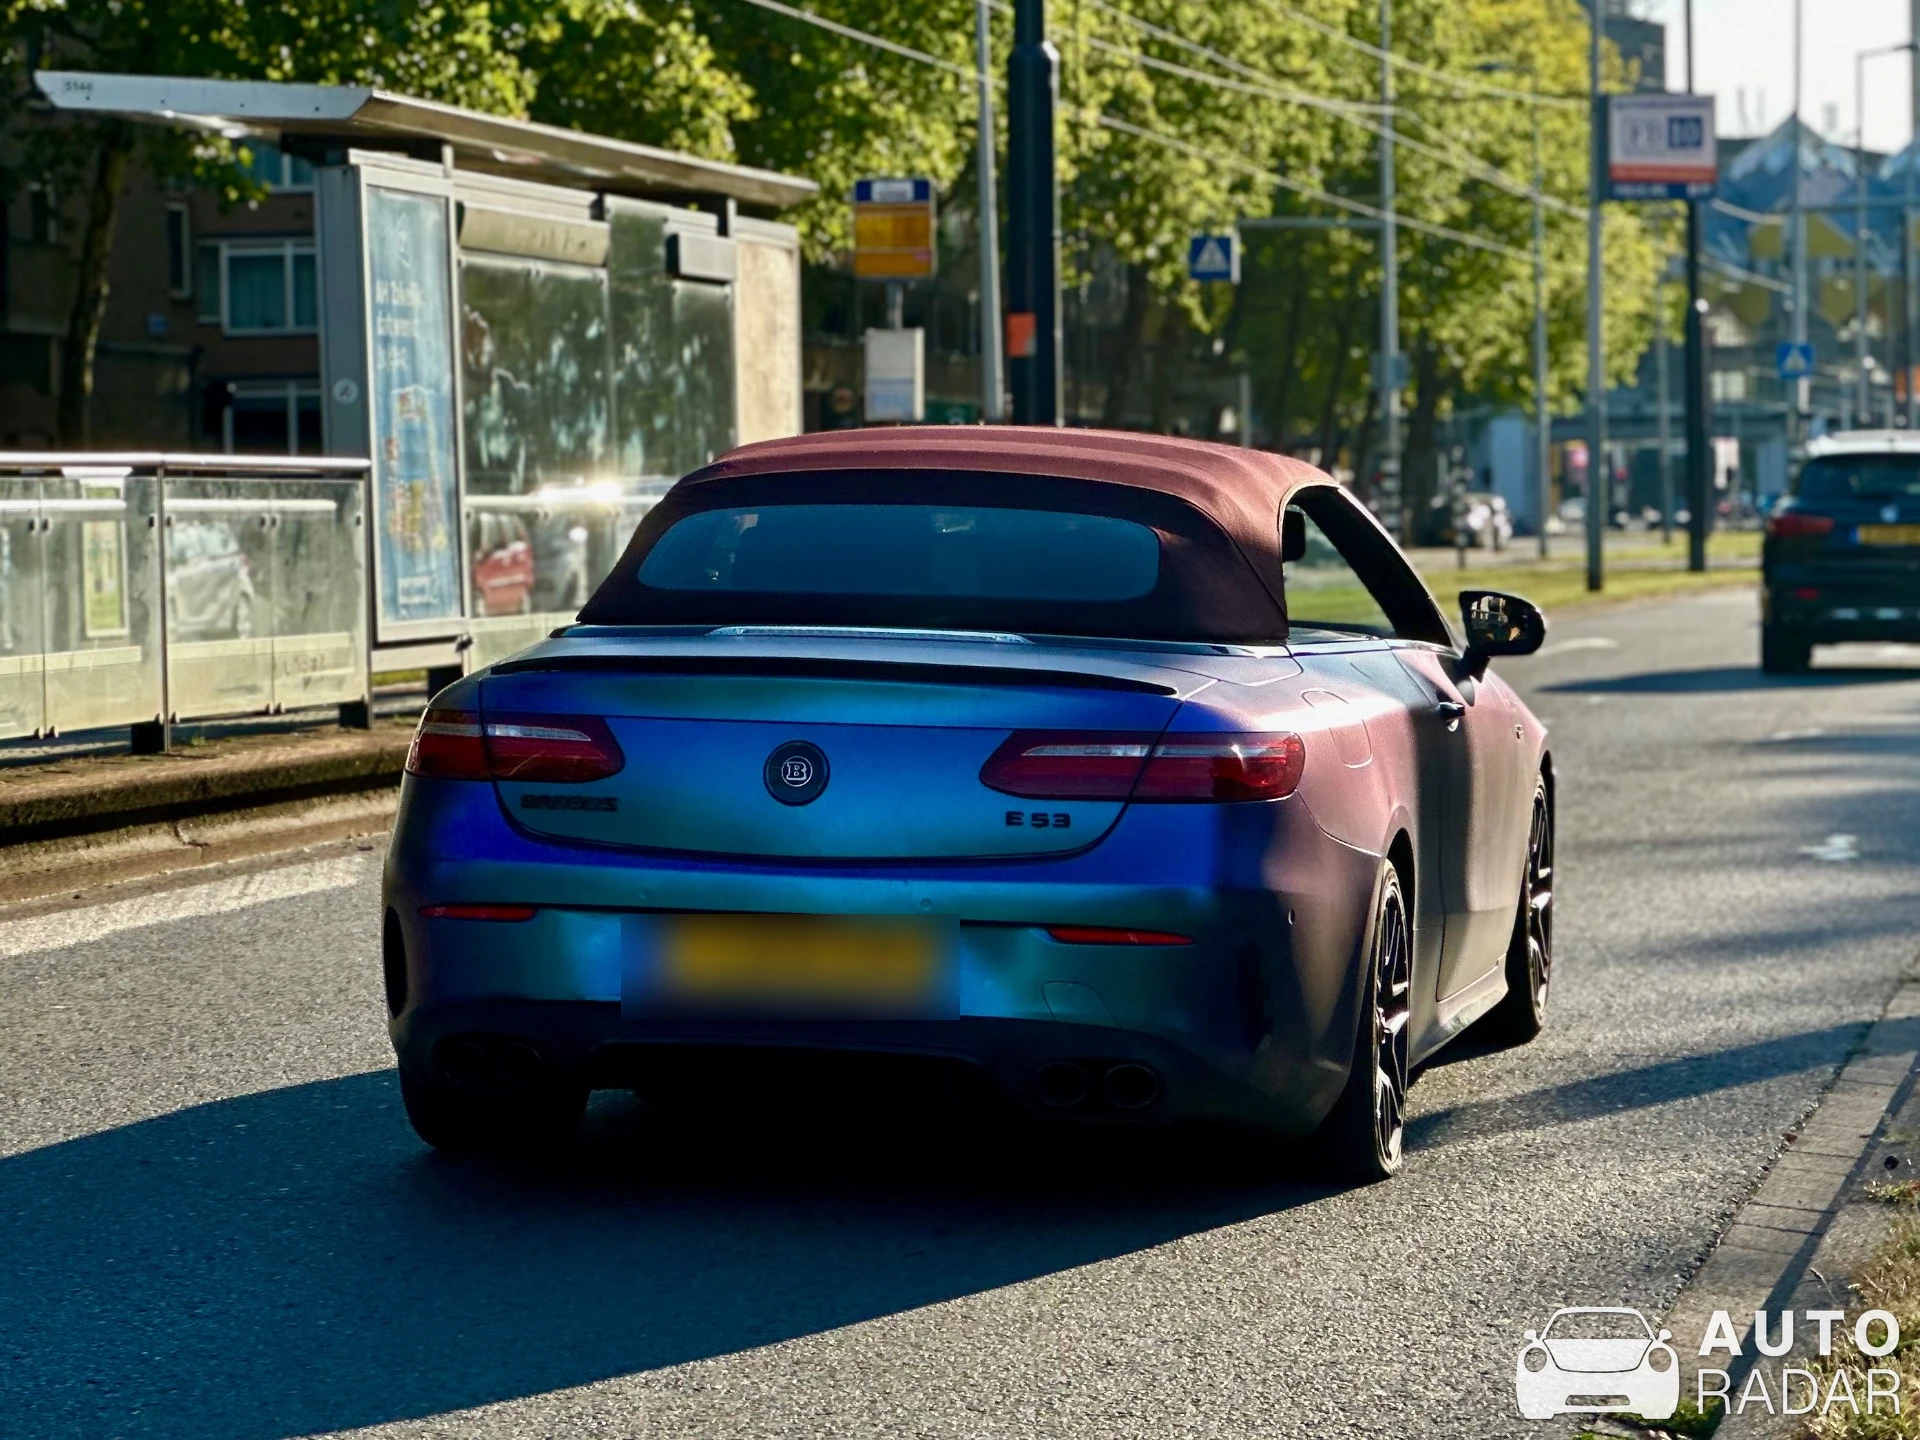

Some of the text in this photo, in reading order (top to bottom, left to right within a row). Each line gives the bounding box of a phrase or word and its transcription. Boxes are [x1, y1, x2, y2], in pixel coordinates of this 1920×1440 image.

[786, 761, 807, 780] B
[1005, 811, 1071, 828] E 53
